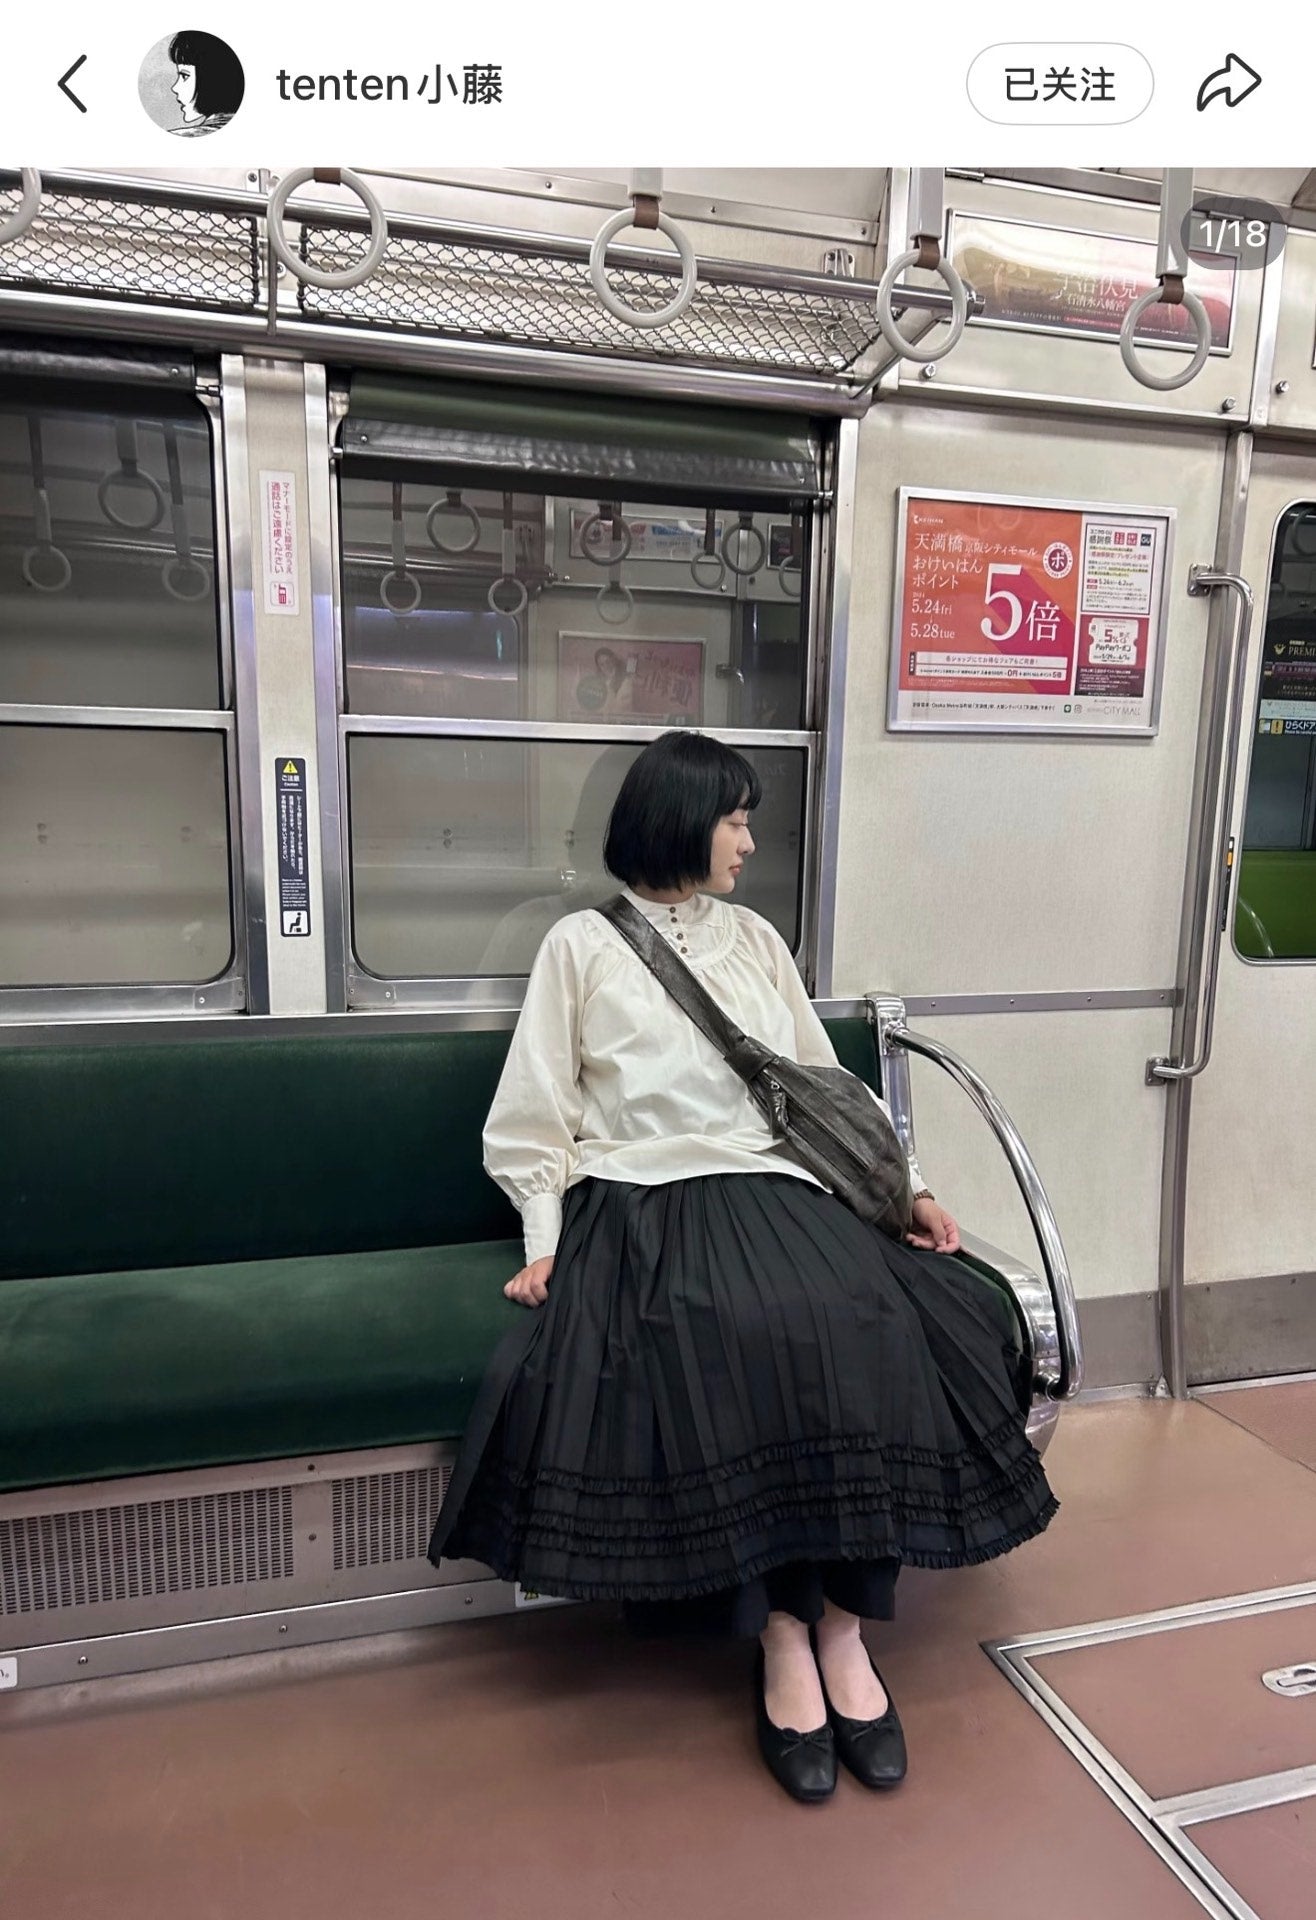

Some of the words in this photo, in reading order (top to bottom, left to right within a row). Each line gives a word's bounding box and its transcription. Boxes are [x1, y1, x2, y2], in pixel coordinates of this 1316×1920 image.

[271, 481, 284, 575] 通話はご遠慮ください
[283, 481, 293, 575] マナーモードに設定のうえ
[912, 555, 983, 574] おけいはん
[1051, 551, 1065, 570] ポ
[912, 573, 959, 590] ポイント
[1288, 646, 1316, 657] PREMI
[1285, 720, 1316, 731] ひらくドア
[281, 774, 300, 783] ご注意
